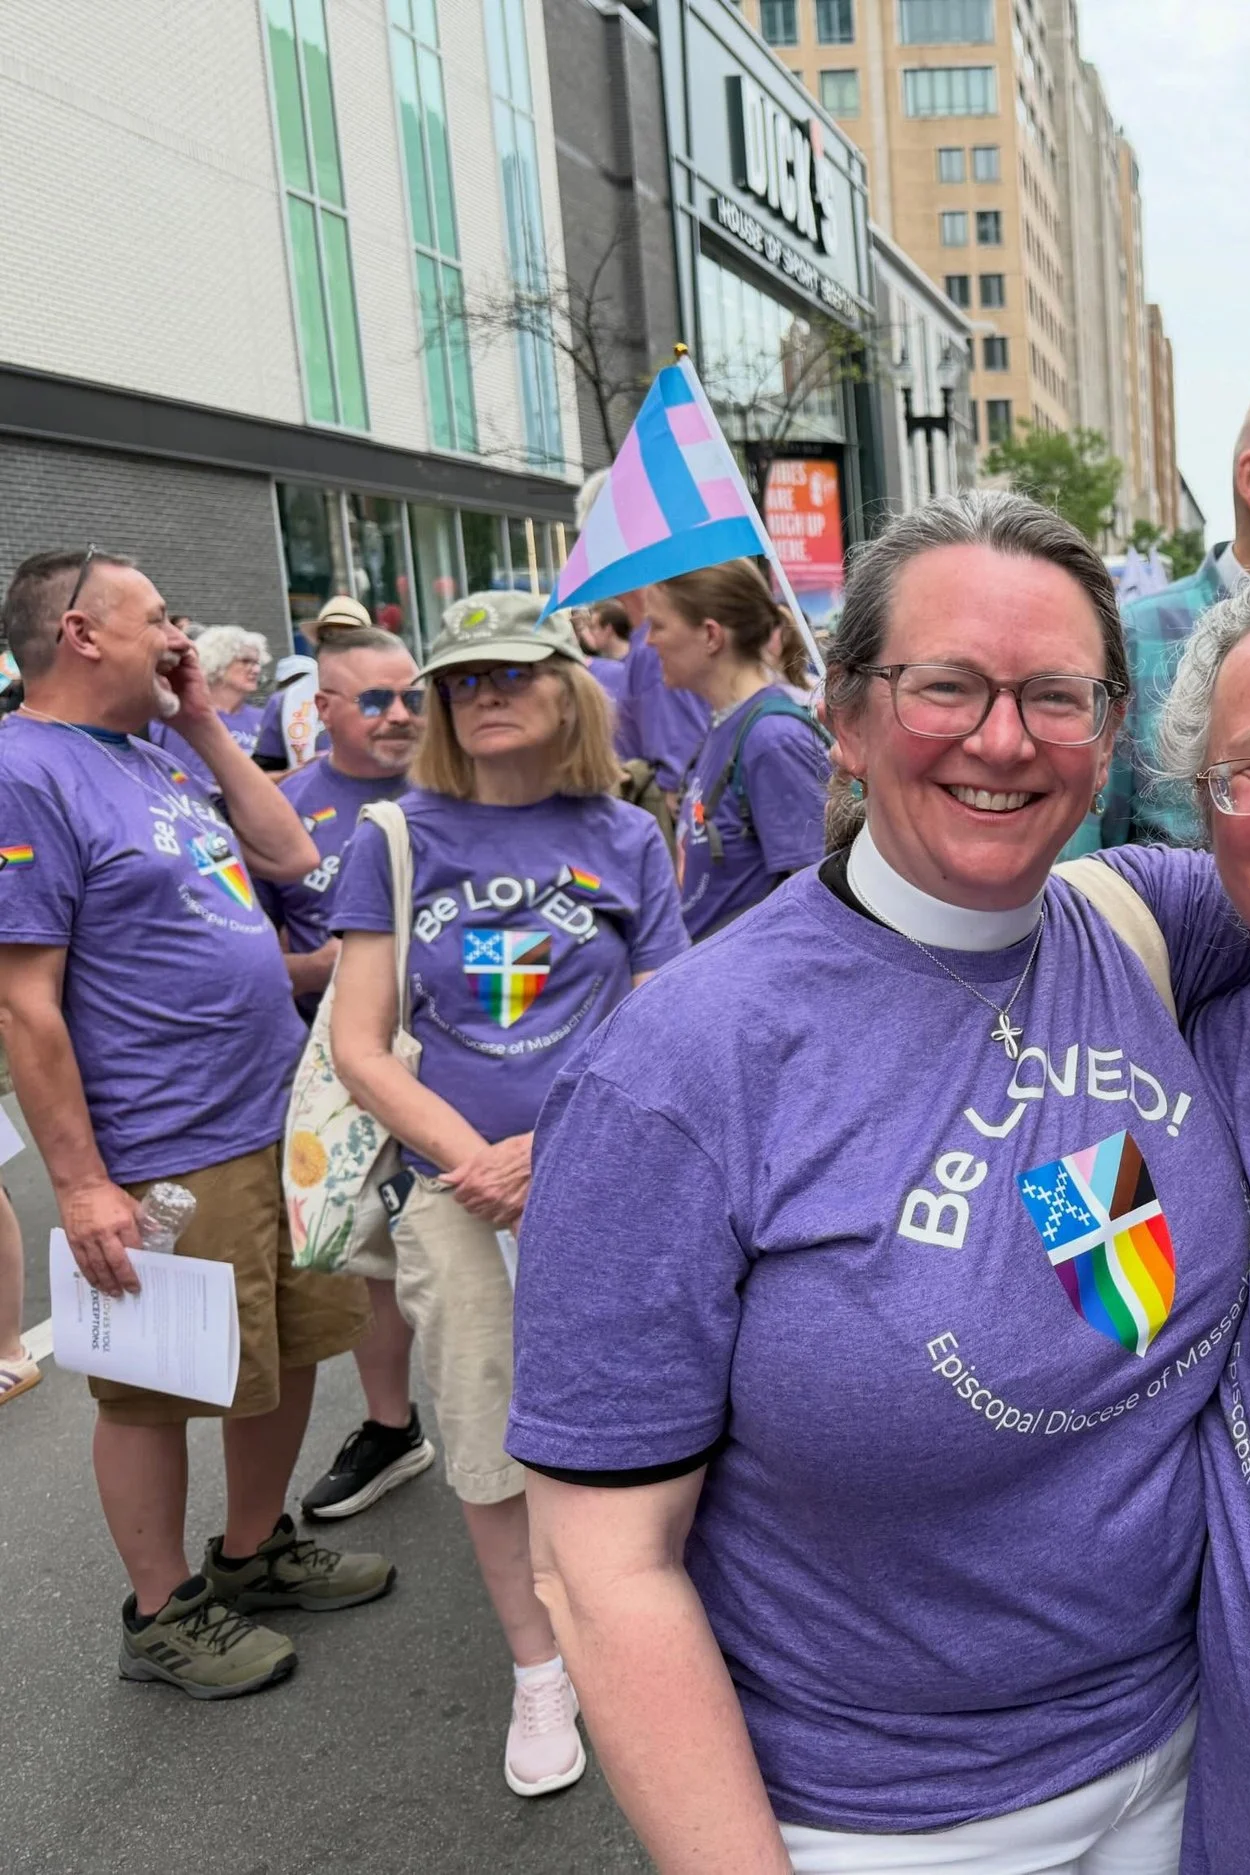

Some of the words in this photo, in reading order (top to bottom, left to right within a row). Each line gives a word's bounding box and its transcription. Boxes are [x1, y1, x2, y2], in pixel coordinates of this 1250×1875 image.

[732, 75, 838, 256] DICK'S
[716, 196, 764, 252] HOUSE
[806, 512, 826, 537] UP
[303, 855, 340, 893] Be
[413, 896, 460, 944] Be
[462, 876, 599, 944] LOVED!
[897, 1150, 989, 1249] Be
[963, 1043, 1192, 1139] LOVED!
[926, 1331, 1044, 1435] Episcopal
[1044, 1392, 1140, 1436] Diocese
[1146, 1367, 1172, 1398] of
